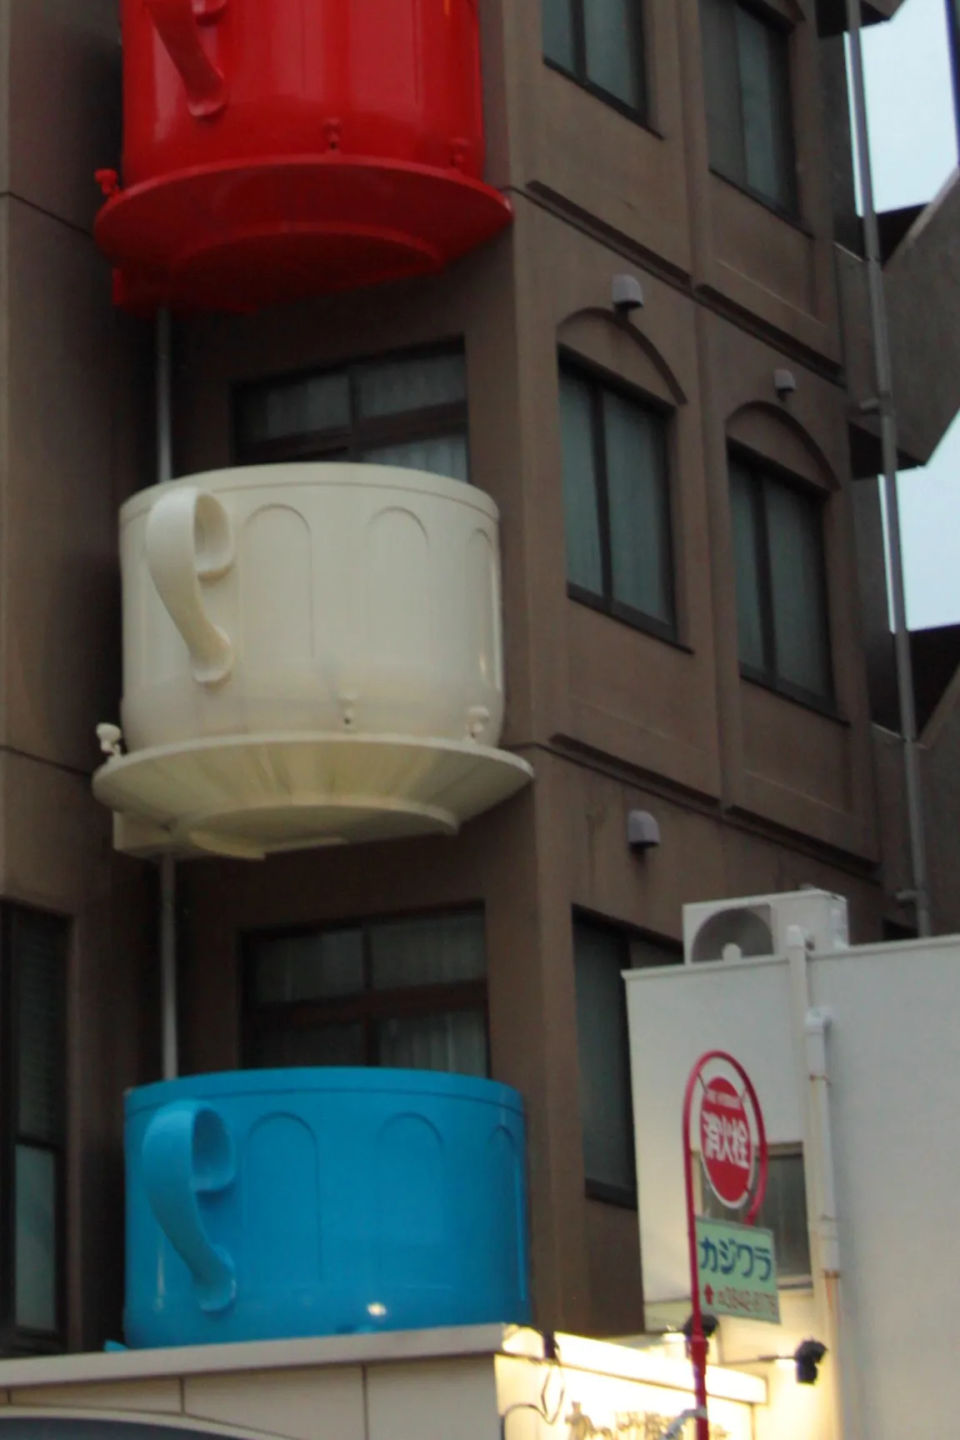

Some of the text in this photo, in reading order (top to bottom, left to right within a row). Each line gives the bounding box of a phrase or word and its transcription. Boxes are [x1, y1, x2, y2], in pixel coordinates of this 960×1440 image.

[701, 1110, 751, 1169] 消火栓
[699, 1237, 773, 1282] カジワラ
